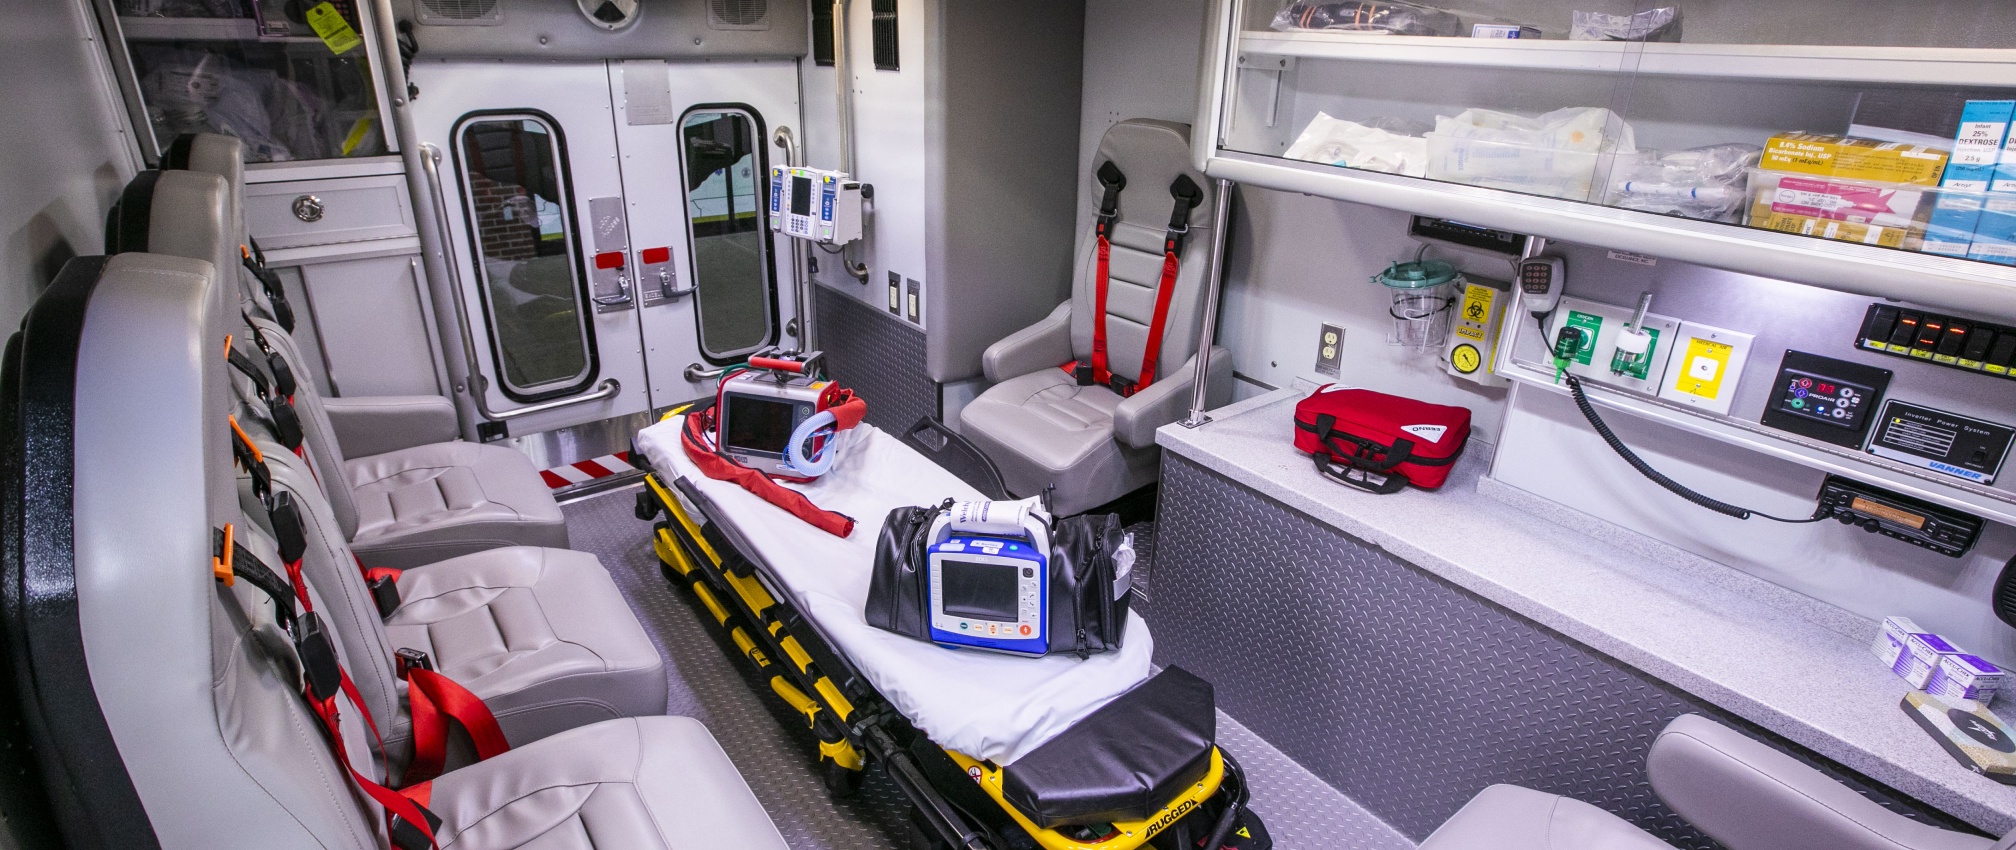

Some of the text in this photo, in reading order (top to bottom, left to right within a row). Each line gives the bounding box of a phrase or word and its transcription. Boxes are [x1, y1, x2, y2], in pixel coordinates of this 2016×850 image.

[1768, 148, 1804, 157] Bicarbonate
[1798, 143, 1824, 152] Sodium
[1809, 393, 1836, 402] PROAIR
[1905, 411, 1990, 436] Inverter Power System
[1929, 461, 1982, 479] VANNER
[960, 502, 970, 523] Welch
[1944, 659, 1970, 678] ACCU-CHEK
[1149, 800, 1192, 834] RUGGED
